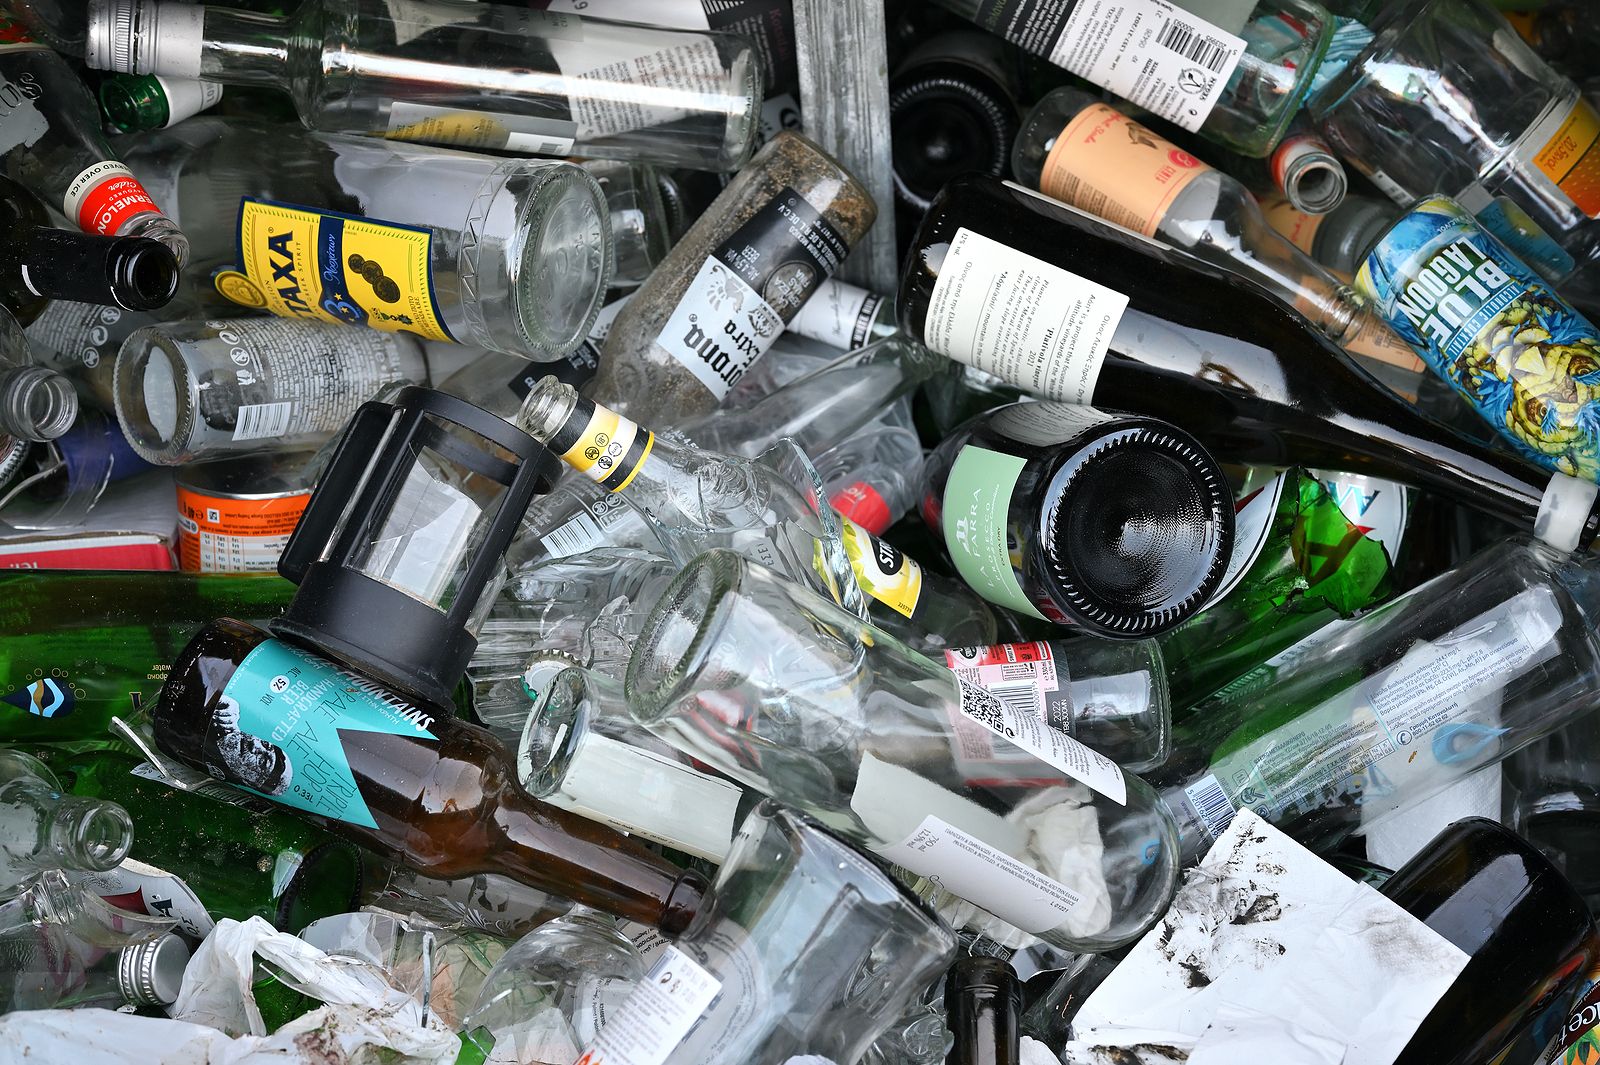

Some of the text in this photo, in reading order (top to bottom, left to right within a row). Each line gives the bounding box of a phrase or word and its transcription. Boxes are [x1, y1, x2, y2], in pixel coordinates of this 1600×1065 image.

[1198, 76, 1217, 102] VEGAN
[70, 167, 100, 196] OVER ICE
[107, 181, 137, 190] Cider
[97, 195, 153, 235] ERMELON
[785, 223, 822, 259] FROM MEXICO
[957, 231, 968, 245] 12%
[295, 242, 303, 271] SPIRIT
[739, 243, 761, 264] BEER
[267, 231, 304, 312] TAXA
[1015, 268, 1026, 284] east
[1019, 274, 1034, 295] These
[1029, 274, 1041, 294] clone
[1395, 236, 1485, 326] LAGOON
[1004, 282, 1021, 307] facing
[1032, 278, 1049, 306] Planted
[1420, 259, 1510, 347] BLUE
[1479, 284, 1520, 321] ALCOHOLIC
[997, 306, 1012, 326] slope
[1007, 295, 1026, 327] ancestral
[1066, 298, 1084, 328] altitude
[974, 311, 994, 342] mountain
[1065, 324, 1083, 351] project
[1447, 317, 1481, 356] COCKTAIL
[681, 322, 744, 389] orona
[722, 319, 761, 368] Extra
[1051, 326, 1073, 360] vineyards
[1062, 350, 1074, 365] that
[1024, 349, 1037, 367] 2021
[968, 487, 981, 556] FARRA
[985, 502, 1001, 579] PROSECCO
[273, 678, 287, 691] 5%
[281, 680, 310, 706] BEER
[271, 678, 335, 741] HANDCRAFTED
[287, 688, 356, 759] PALE ALE
[1427, 701, 1459, 722] Καταναλωτή
[293, 784, 314, 804] 0.33L
[316, 772, 358, 819] TRIPLE
[1186, 787, 1195, 795] 5
[923, 832, 939, 849] 750
[952, 838, 974, 854] PRODUCED
[1048, 890, 1061, 900] FROM
[1059, 895, 1074, 908] GREECE
